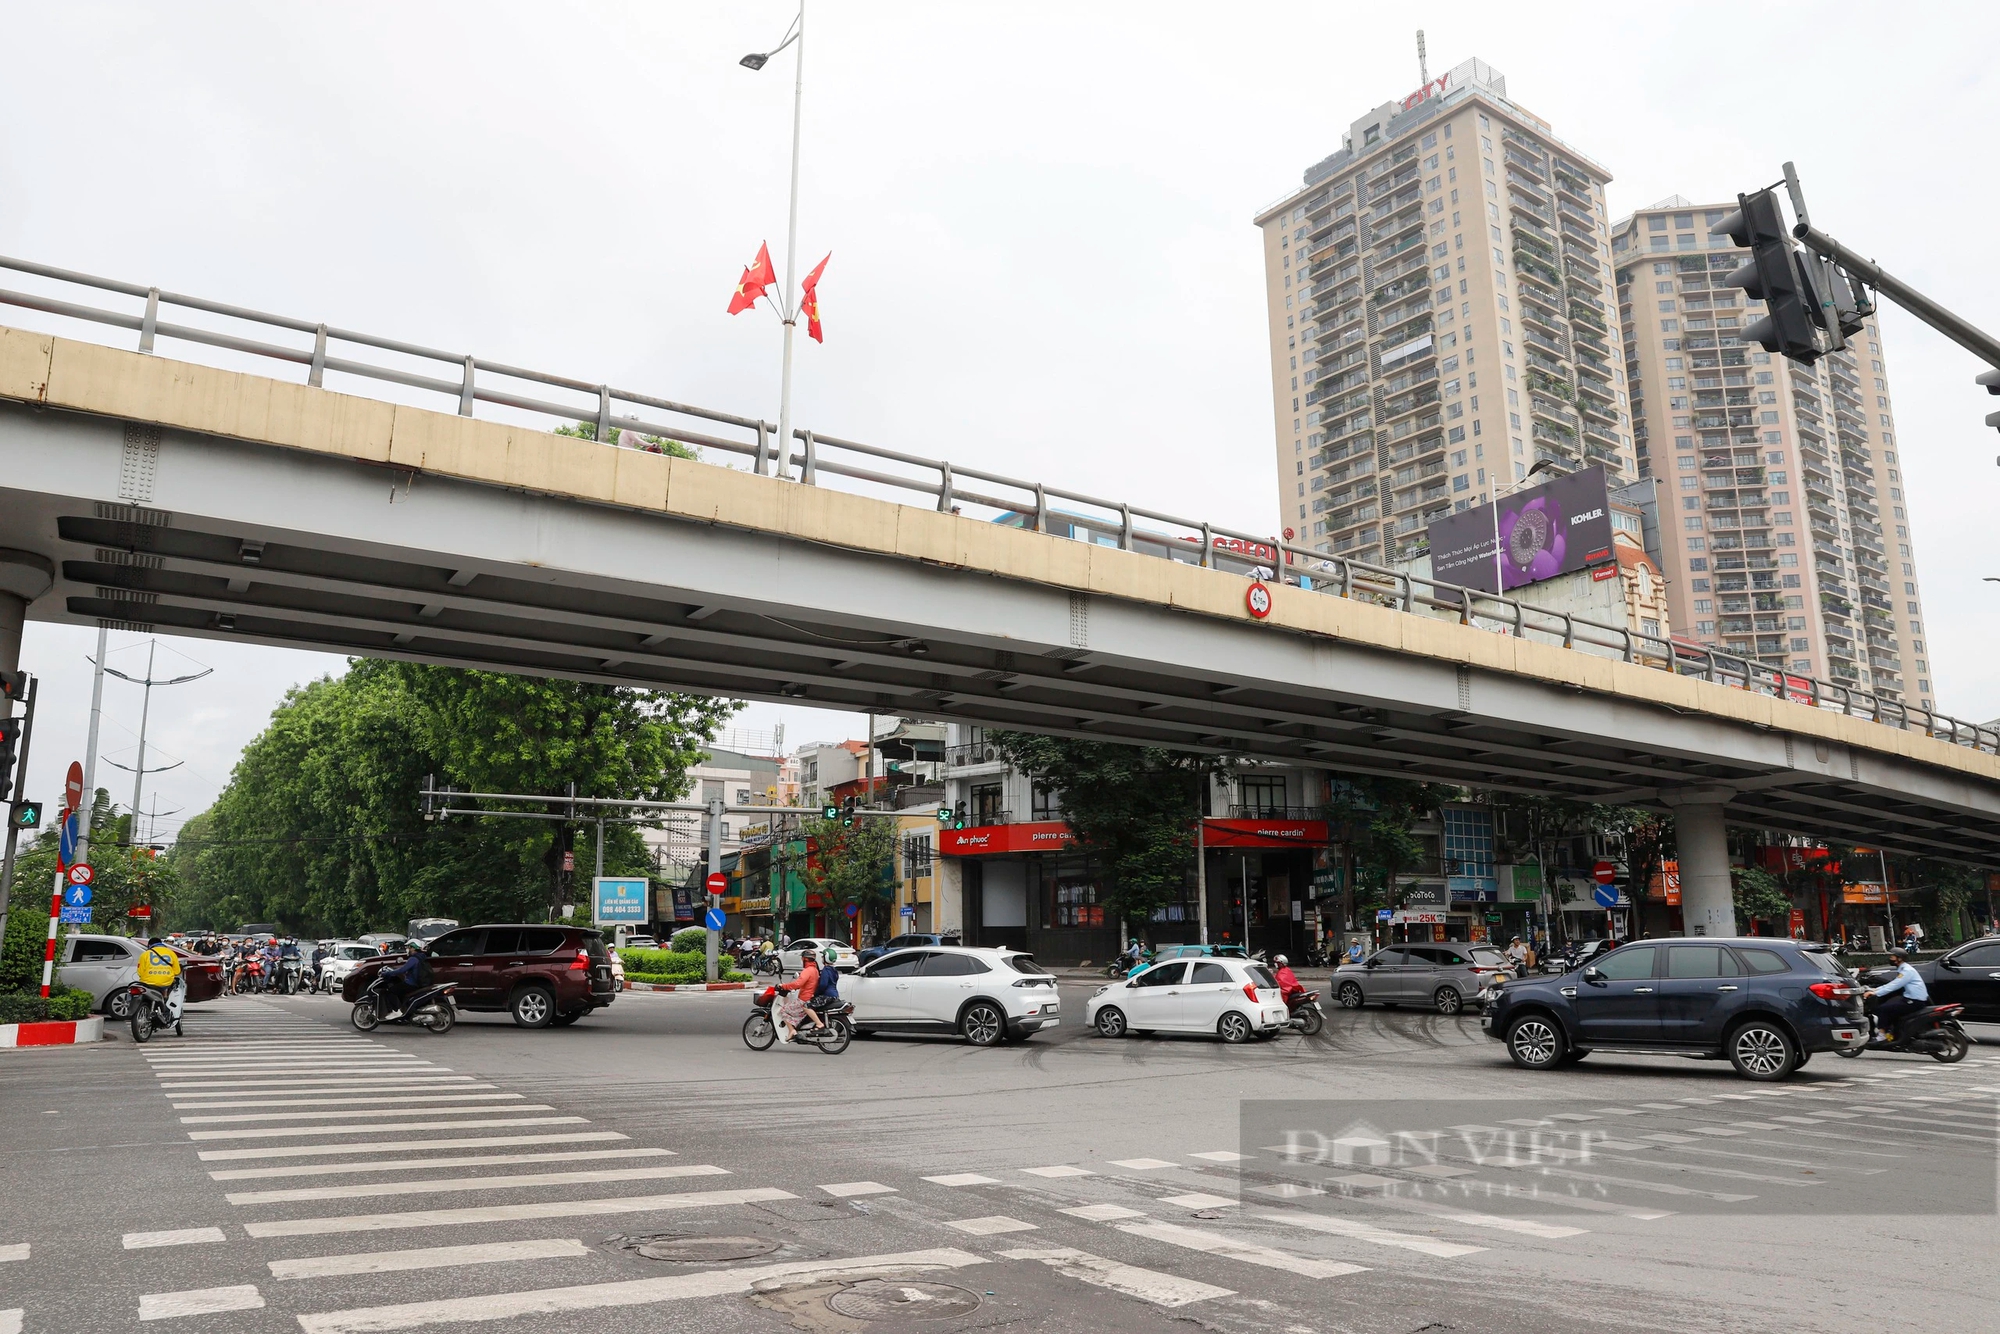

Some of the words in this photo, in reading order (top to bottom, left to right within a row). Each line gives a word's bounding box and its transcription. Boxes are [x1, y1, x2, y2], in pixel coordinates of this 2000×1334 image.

[1405, 72, 1449, 110] CITY
[827, 808, 836, 818] 12
[940, 810, 950, 820] 52
[1033, 832, 1057, 841] pierre
[1258, 828, 1279, 837] pierre
[1280, 828, 1303, 837] cardin
[1420, 914, 1436, 922] 25K
[149, 951, 171, 966] be
